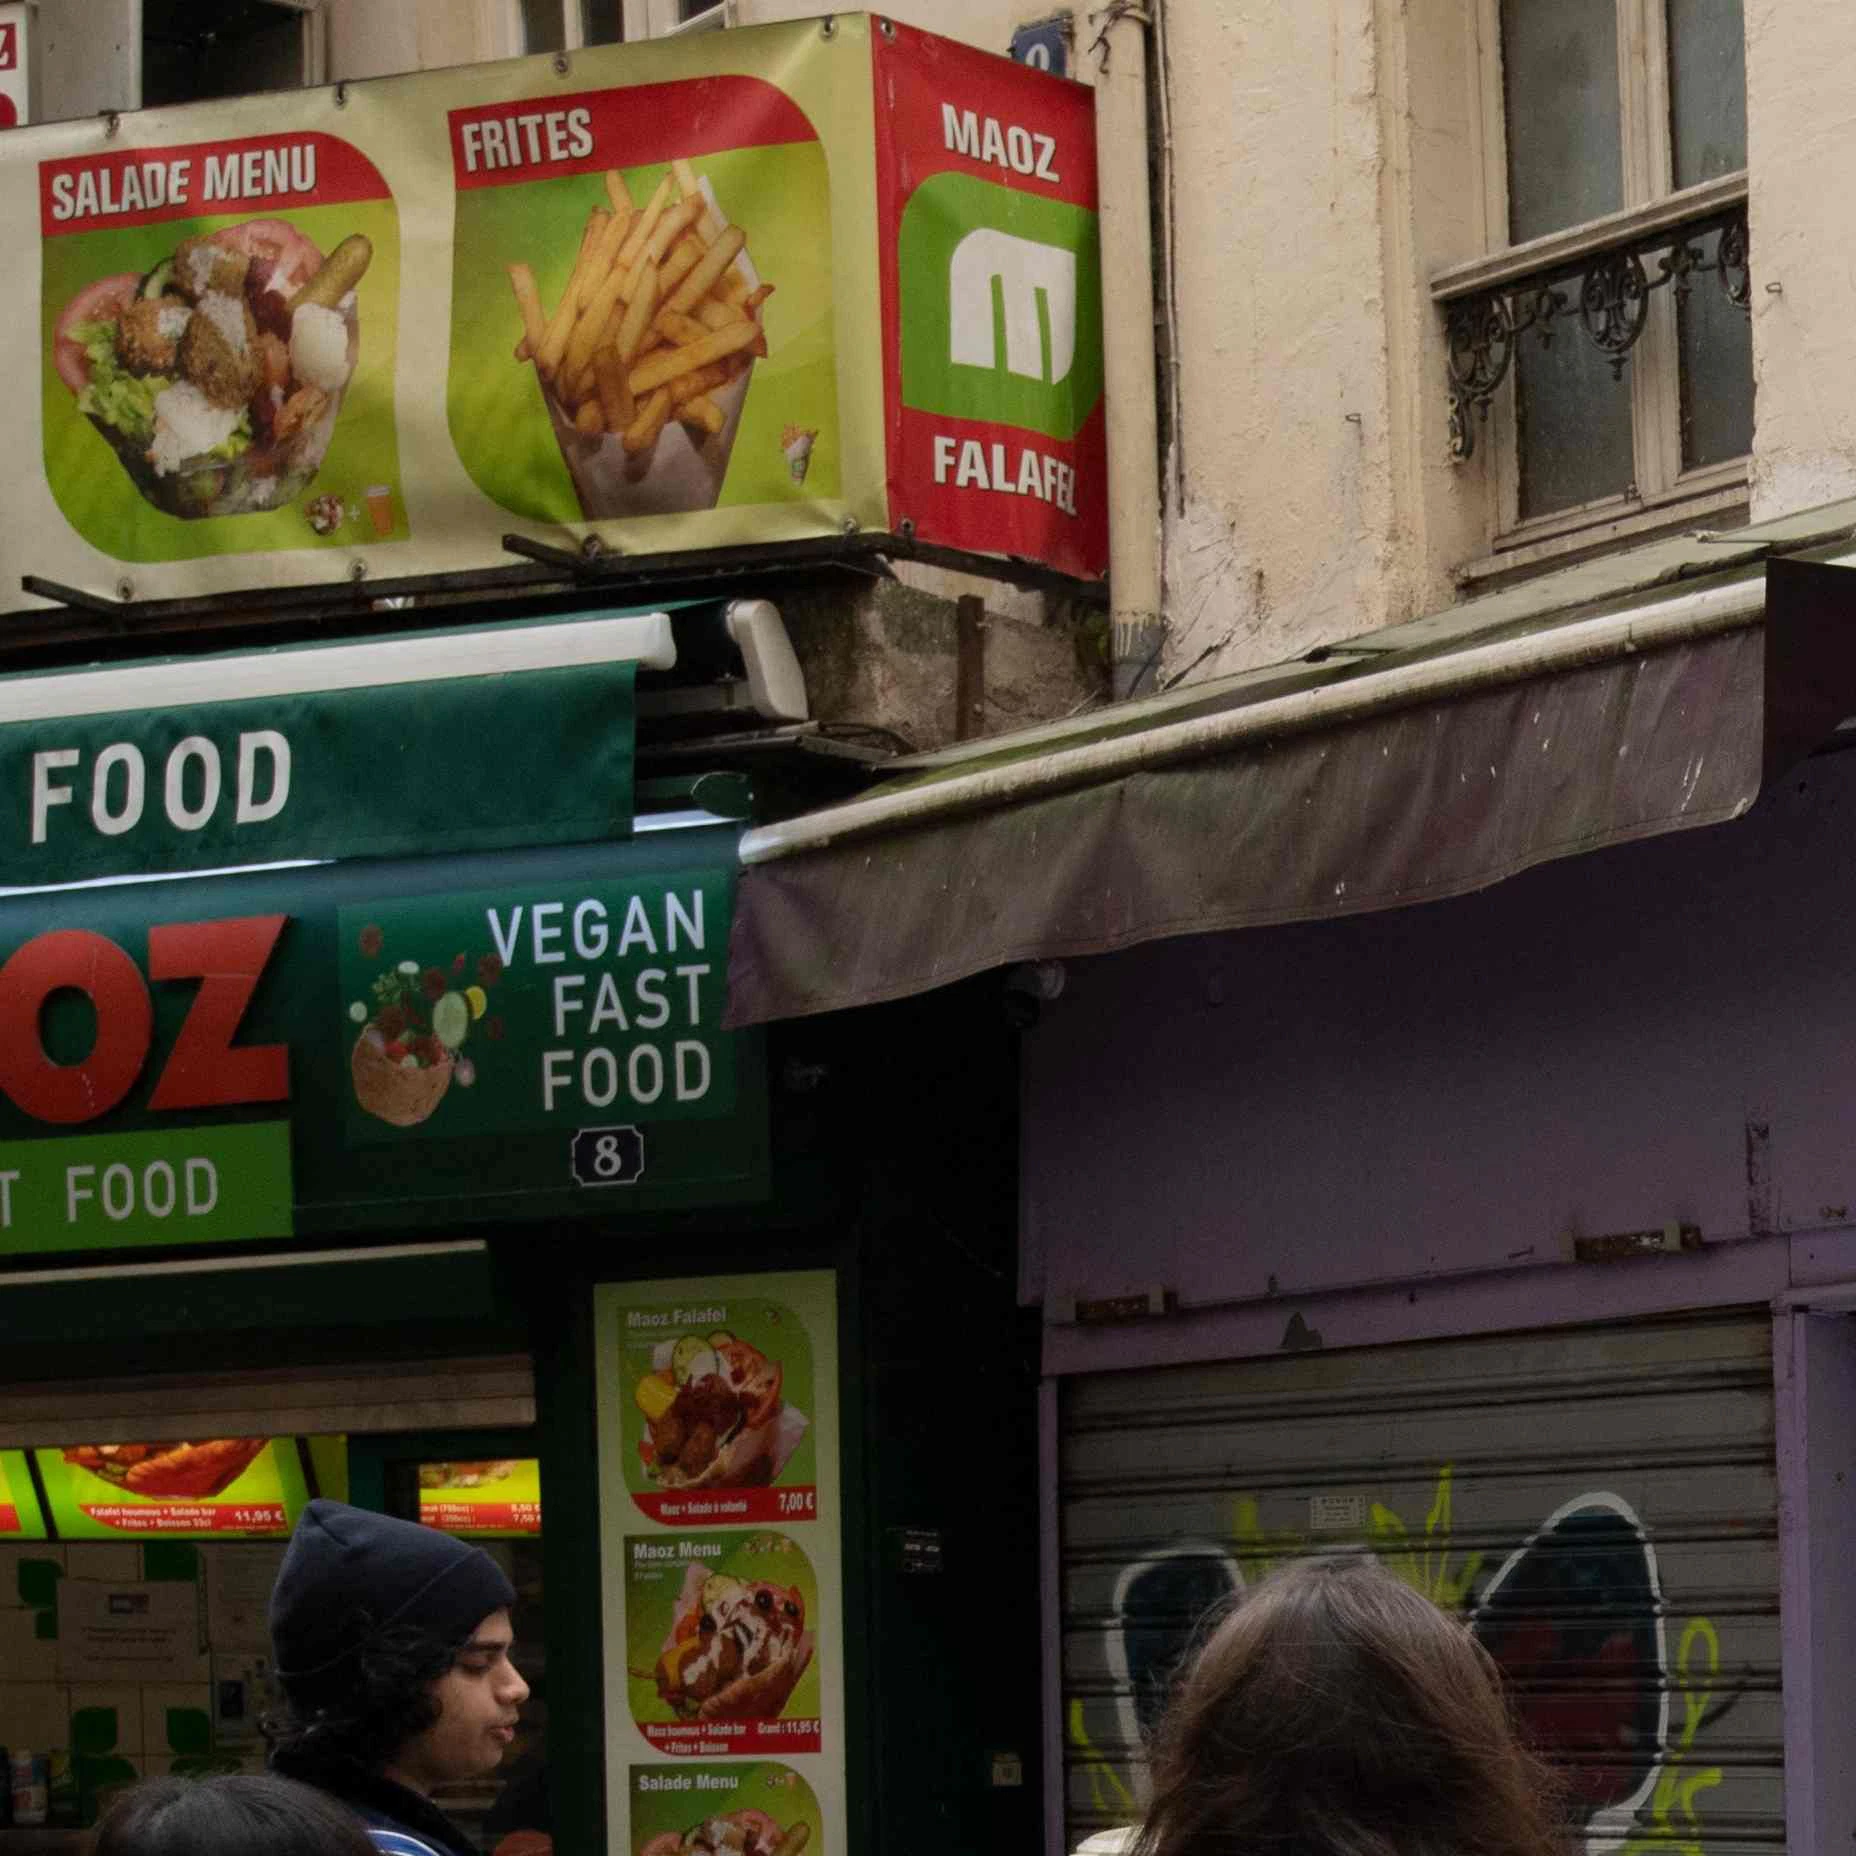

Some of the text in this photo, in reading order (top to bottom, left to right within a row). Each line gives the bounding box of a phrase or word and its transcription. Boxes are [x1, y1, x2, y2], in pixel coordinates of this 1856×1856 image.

[461, 107, 593, 173] FRITES
[941, 101, 1061, 183] MAOZ
[52, 143, 317, 221] SALADE MENU
[933, 435, 1078, 517] FALAFEL
[31, 729, 292, 844] FOOD
[487, 889, 705, 967] VEGAN
[553, 964, 711, 1037] FAST
[541, 1040, 712, 1111] FOOD
[66, 1156, 219, 1224] FOOD
[594, 1135, 623, 1178] 8
[627, 1307, 728, 1328] Maoz Falafel
[779, 1492, 803, 1513] 7,00
[633, 1541, 722, 1560] Maoz Menu
[639, 1773, 739, 1791] Salade Menu
